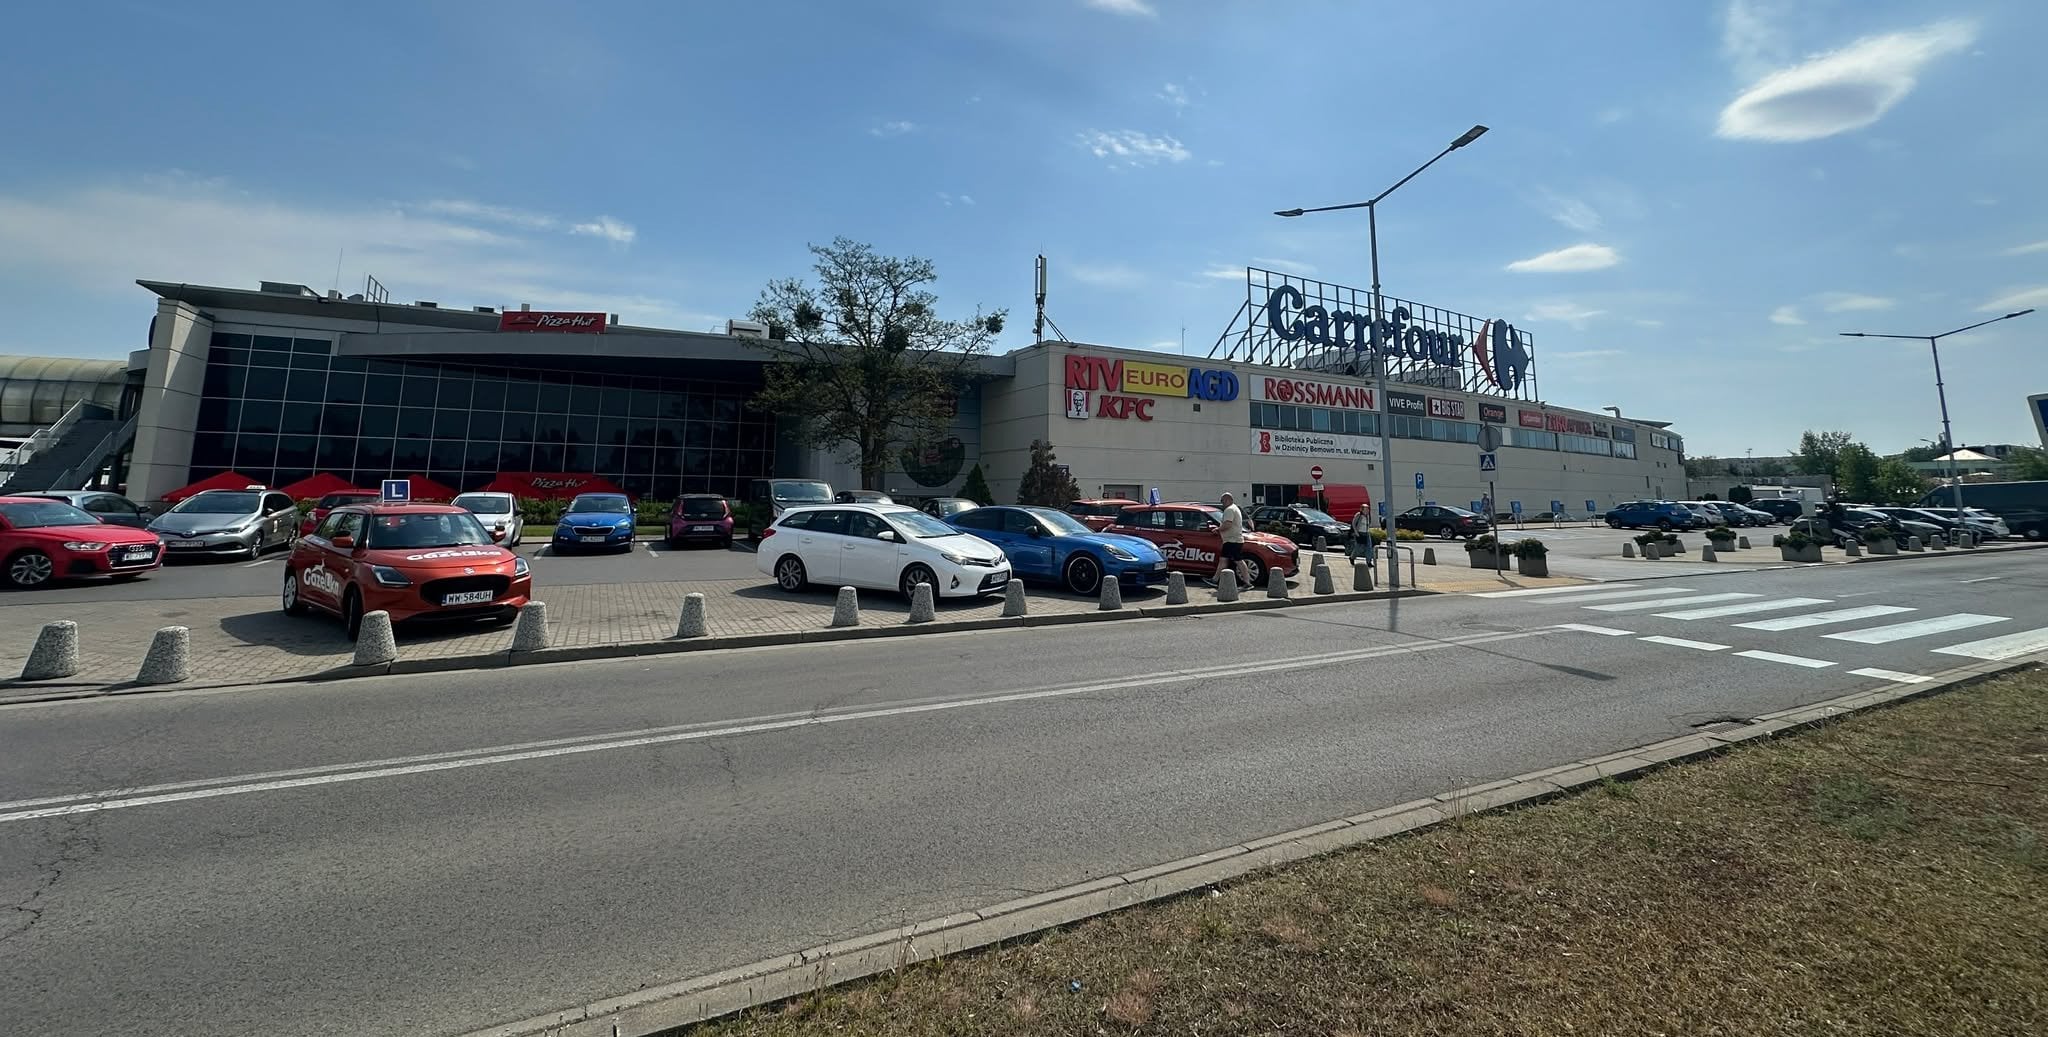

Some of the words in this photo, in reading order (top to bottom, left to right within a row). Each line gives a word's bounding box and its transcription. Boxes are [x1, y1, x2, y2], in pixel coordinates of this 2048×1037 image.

[537, 314, 570, 327] Pizza
[571, 315, 597, 327] Hut
[1269, 285, 1464, 368] Carrefour
[1065, 355, 1123, 392] RTV
[1126, 369, 1185, 389] EURO
[1188, 368, 1240, 402] AGD
[1264, 377, 1374, 409] ROSSMANN
[1097, 395, 1154, 420] KFC
[1389, 398, 1405, 409] VIVE
[1406, 400, 1424, 411] Profit
[1441, 400, 1451, 415] BIG
[1451, 401, 1465, 416] STAR
[1483, 406, 1504, 418] Orange
[1275, 435, 1305, 444] Biblioteka
[1306, 437, 1334, 445] Publiczna
[1282, 444, 1309, 453] Dzielnicy
[1351, 449, 1377, 457] Warszawy
[531, 477, 563, 488] Pizza
[1417, 475, 1423, 485] P
[392, 484, 403, 497] L
[448, 594, 461, 604] WW
[463, 591, 493, 602] 584UH
